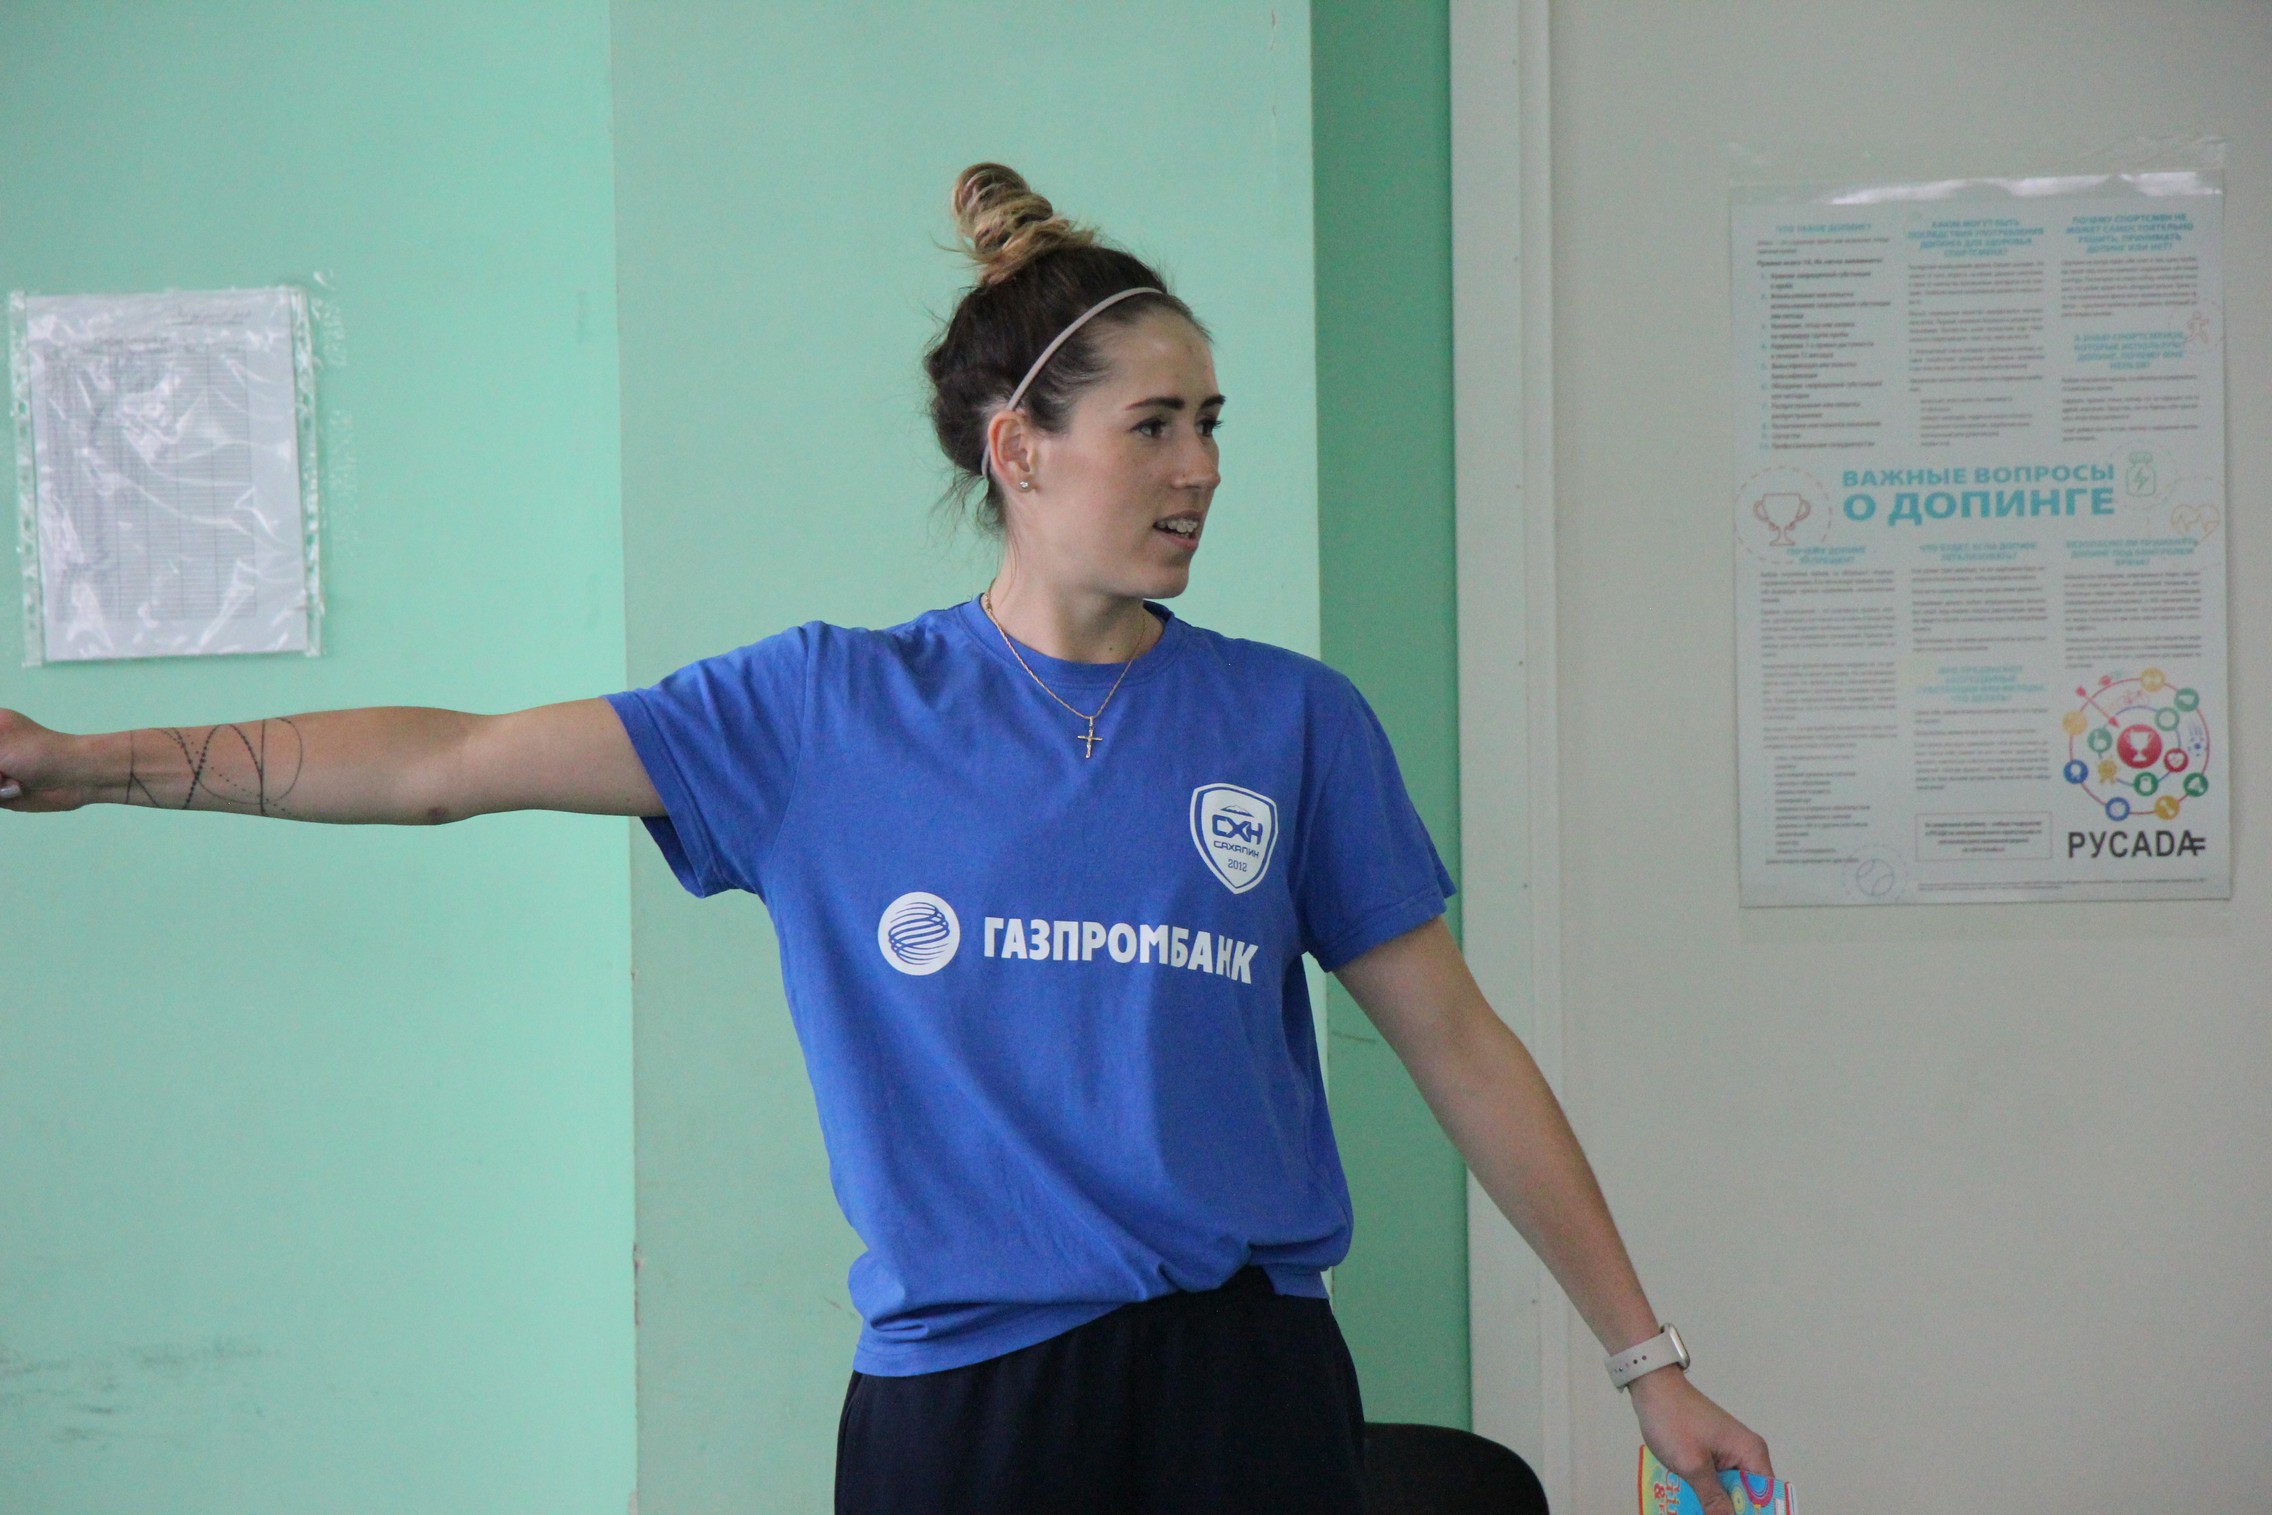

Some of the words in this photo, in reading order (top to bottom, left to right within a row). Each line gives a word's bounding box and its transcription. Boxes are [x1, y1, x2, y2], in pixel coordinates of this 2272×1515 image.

[1842, 468, 1968, 487] ВАЖНЫЕ
[1974, 463, 2115, 484] ВОПРОСЫ
[1843, 493, 1877, 522] О
[1888, 487, 2115, 527] ДОПИНГЕ
[1227, 858, 1248, 872] 2012
[983, 916, 1259, 985] ГАЗПРОМБАНК
